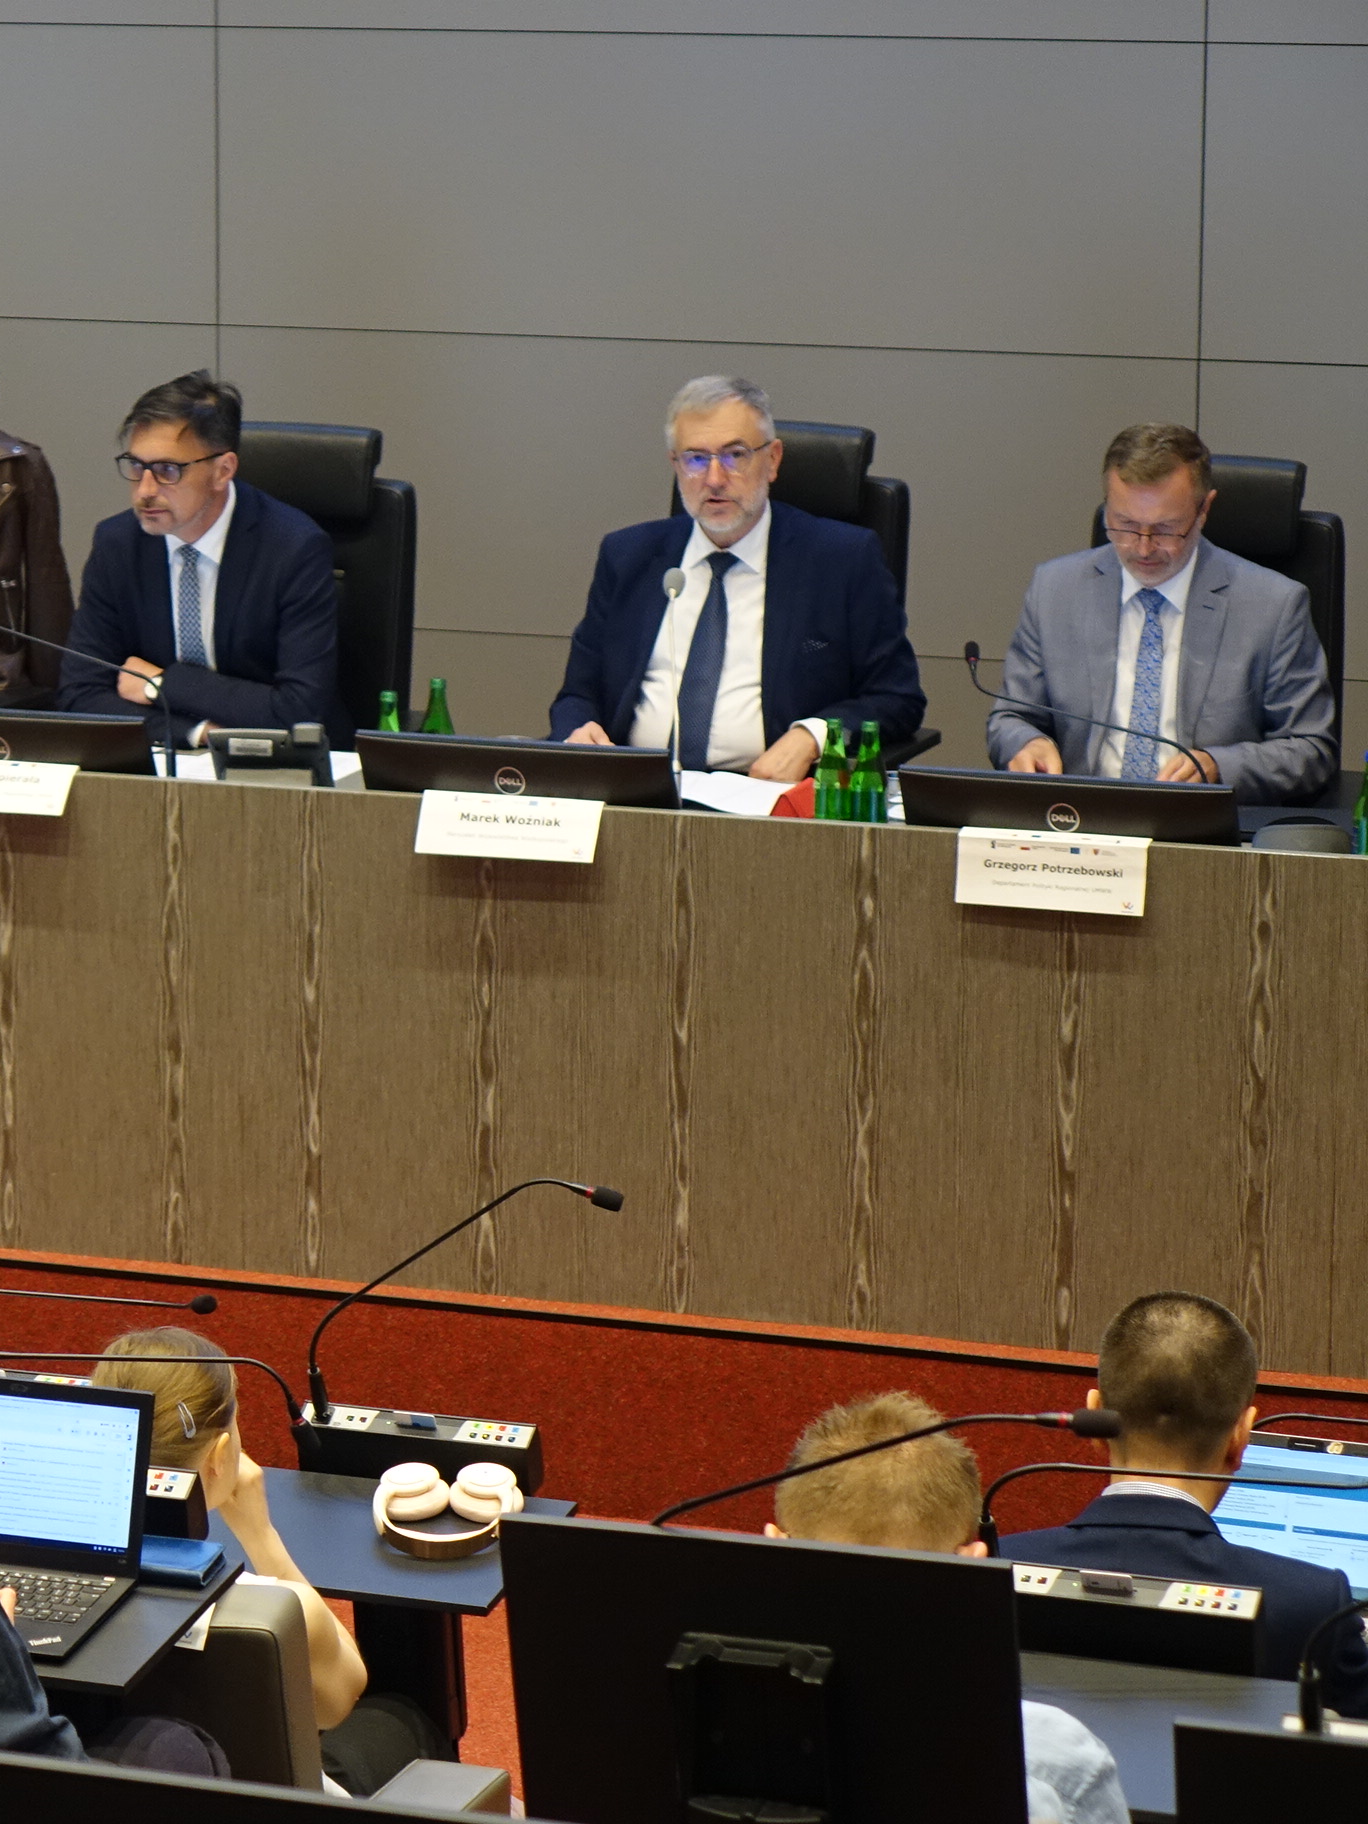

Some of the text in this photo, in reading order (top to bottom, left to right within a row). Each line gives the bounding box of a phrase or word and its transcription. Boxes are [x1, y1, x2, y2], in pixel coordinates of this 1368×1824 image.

[498, 776, 523, 786] DELL
[460, 812, 499, 824] Marek
[1051, 813, 1077, 823] DELL
[984, 859, 1124, 878] Grzegorz Potrzebowski
[28, 1636, 62, 1646] ThinkPad
